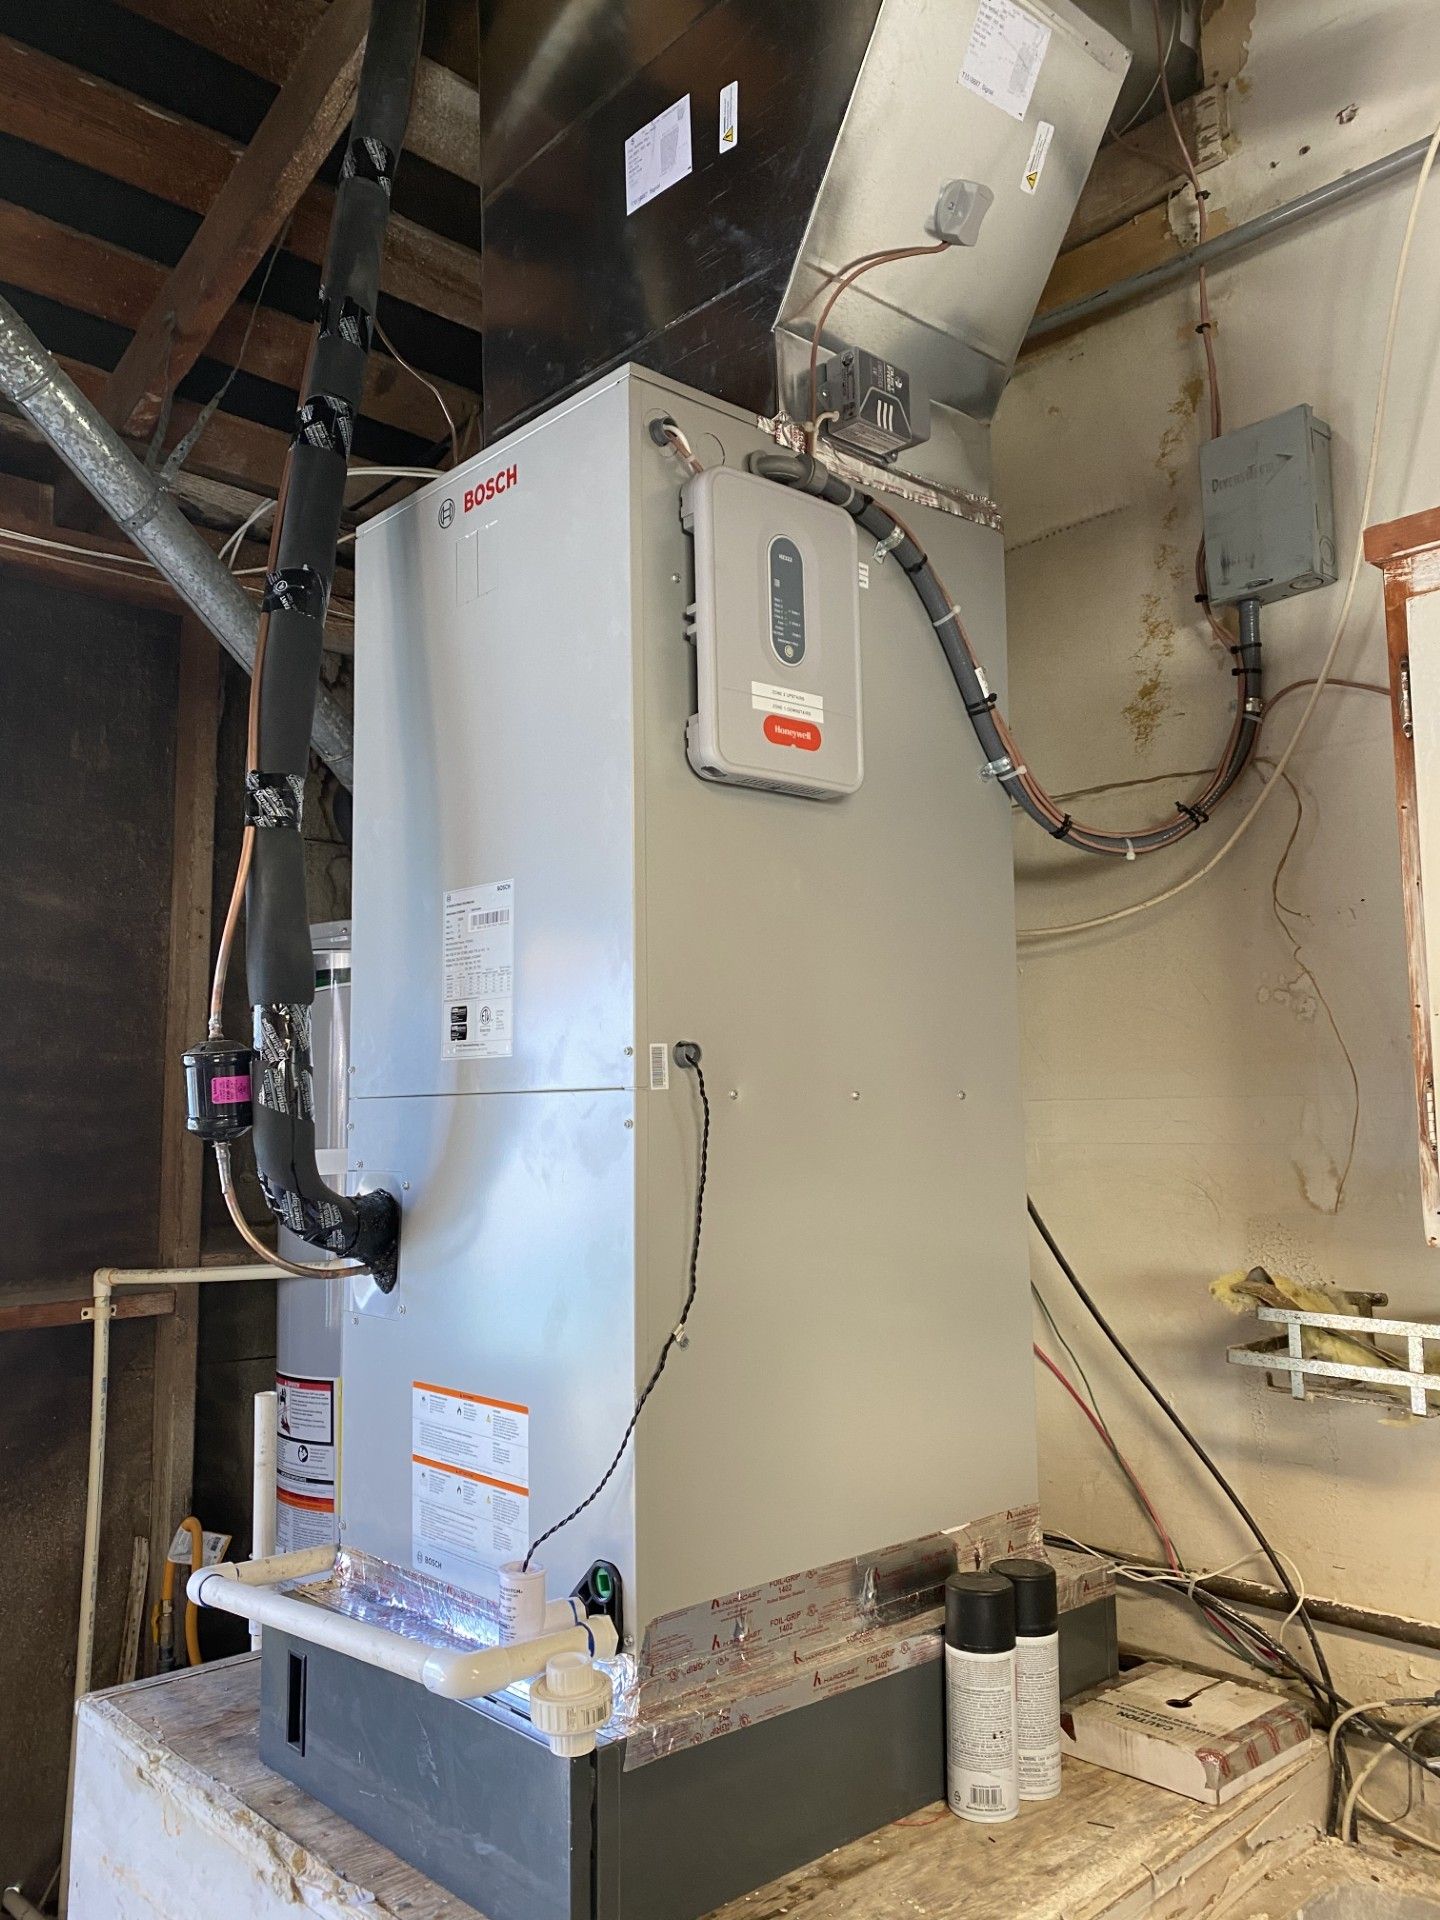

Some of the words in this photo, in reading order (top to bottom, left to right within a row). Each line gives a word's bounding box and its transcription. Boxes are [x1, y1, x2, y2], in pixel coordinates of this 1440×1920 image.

[464, 463, 518, 514] BOSCH
[774, 724, 812, 741] Honeywell
[424, 1555, 442, 1570] BOSCH
[769, 1610, 802, 1627] FOIL-GRIP
[779, 1623, 794, 1634] 1402
[866, 1648, 896, 1665] FOIL-GRIP
[1116, 1711, 1174, 1731] CAUTION
